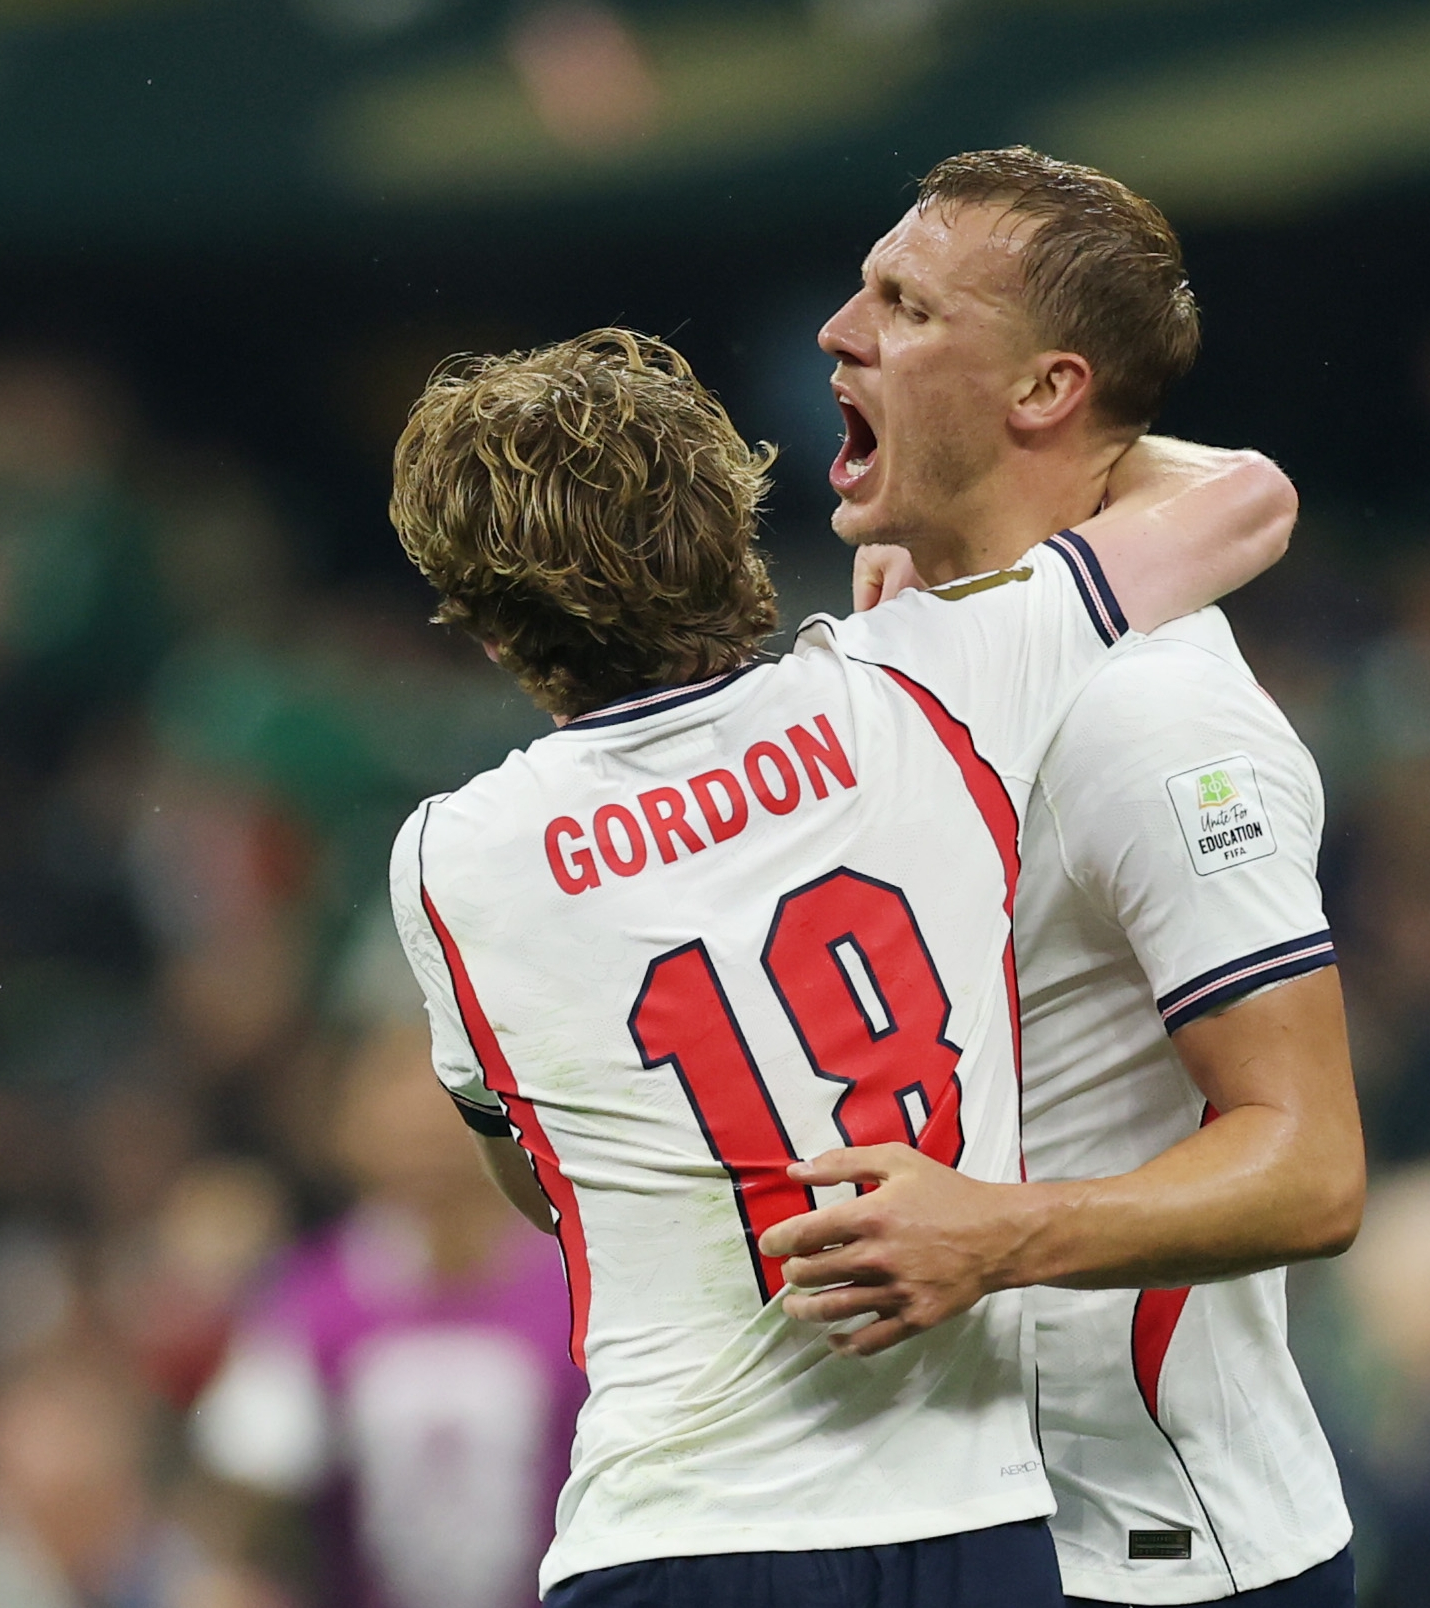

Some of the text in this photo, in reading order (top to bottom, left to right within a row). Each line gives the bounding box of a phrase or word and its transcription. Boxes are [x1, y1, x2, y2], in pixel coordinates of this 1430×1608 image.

[543, 713, 858, 896] GORDON
[1200, 802, 1248, 833] Unite For
[1198, 821, 1264, 855] EDUCATION
[1223, 846, 1248, 861] FIFA
[627, 864, 966, 1308] 18
